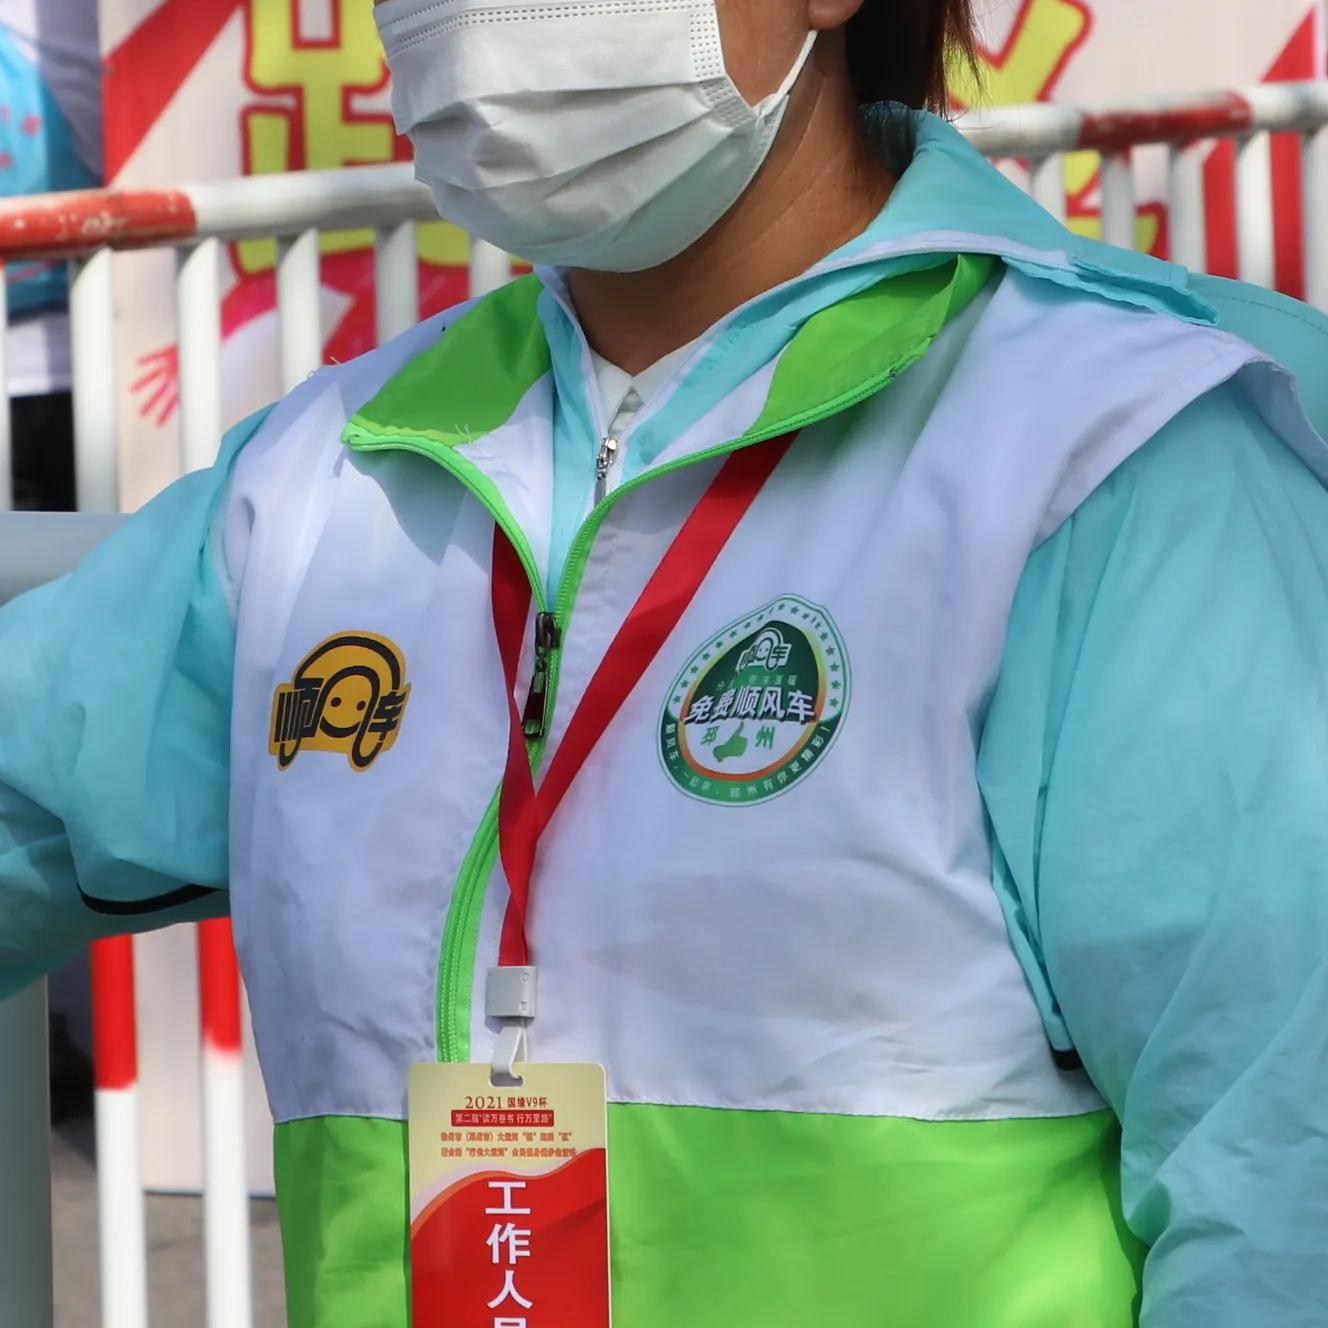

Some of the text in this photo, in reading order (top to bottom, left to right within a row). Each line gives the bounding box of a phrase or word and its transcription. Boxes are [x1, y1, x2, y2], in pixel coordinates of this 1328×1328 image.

[684, 684, 816, 724] 免费顺风车
[484, 1180, 534, 1328] 工作人
